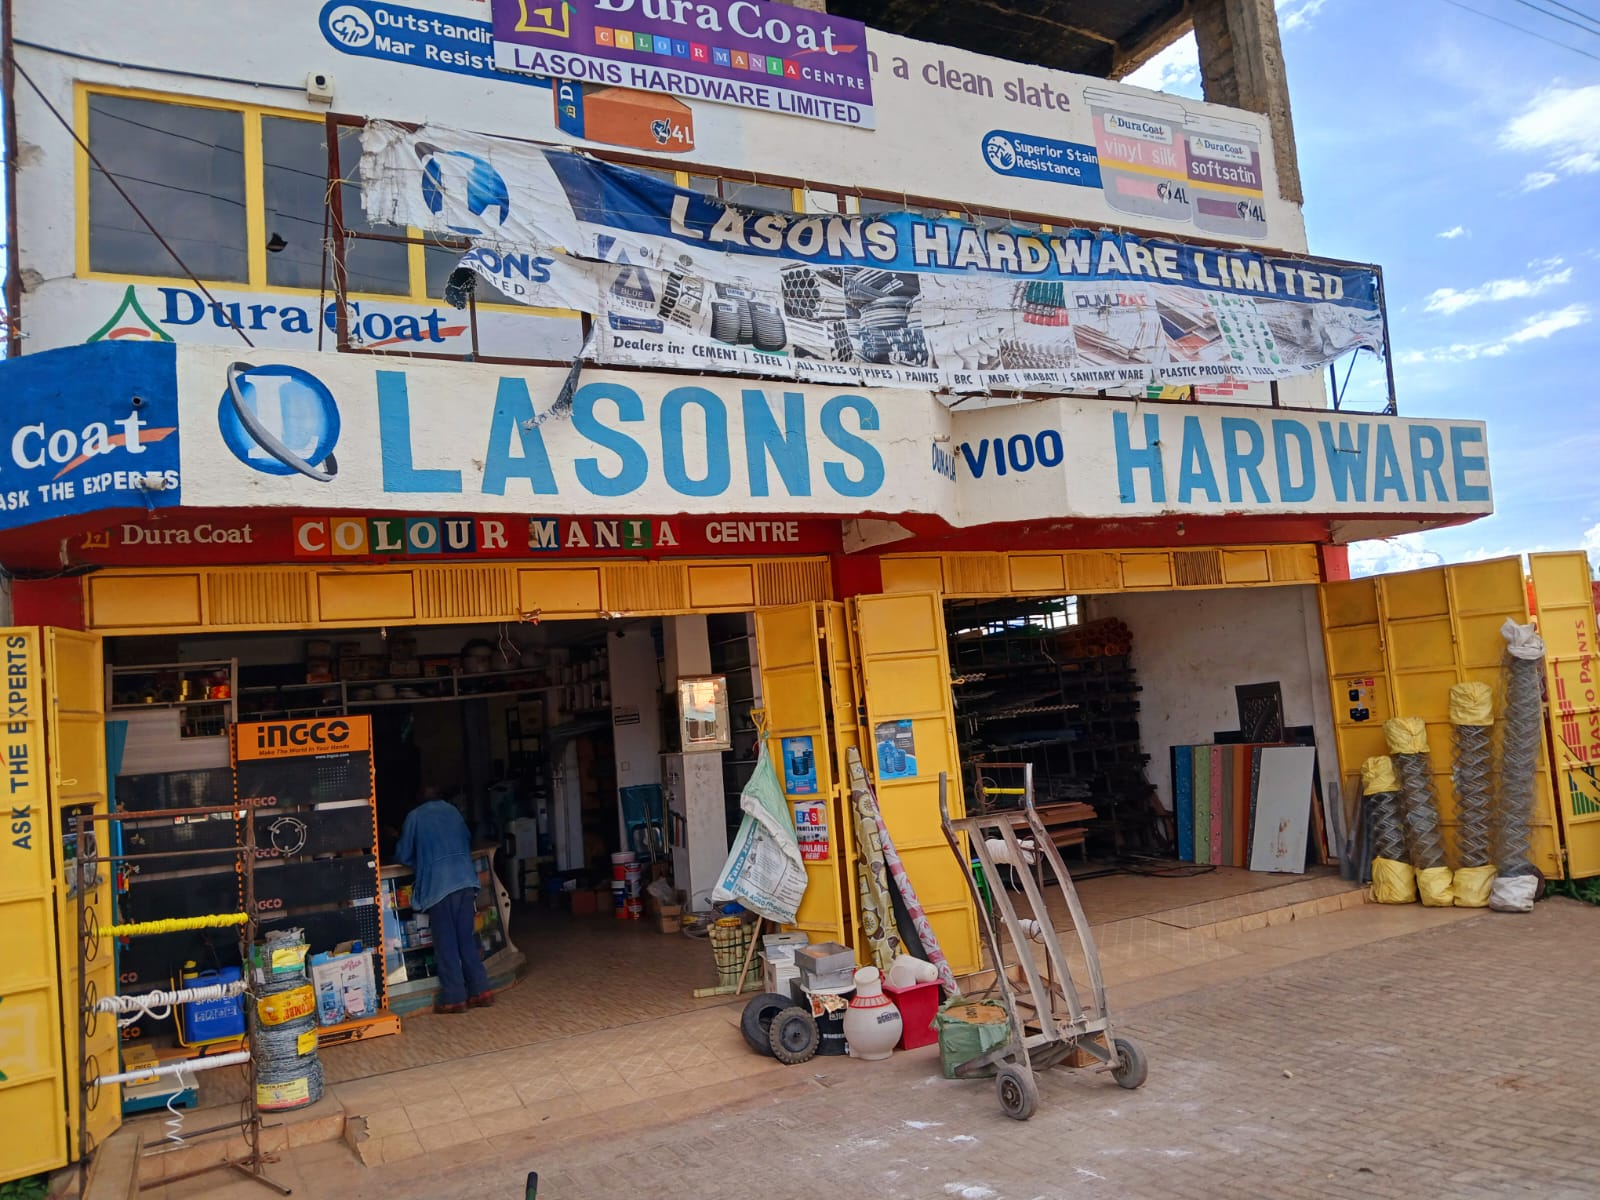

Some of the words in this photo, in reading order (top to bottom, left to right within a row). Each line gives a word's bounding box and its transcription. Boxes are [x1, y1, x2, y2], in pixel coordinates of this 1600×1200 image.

[374, 9, 494, 45] Outstandin
[375, 34, 415, 56] Mar
[597, 29, 705, 60] COLOUR
[714, 49, 797, 78] MANIA
[802, 67, 865, 90] CENTRE
[514, 48, 623, 84] LASONS
[631, 68, 771, 108] HARDWARE
[778, 92, 862, 124] LIMITED
[892, 56, 910, 80] a
[922, 60, 994, 98] clean
[1004, 77, 1071, 113] slate
[671, 124, 694, 145] 4L
[1014, 139, 1063, 158] Superior
[1066, 148, 1098, 165] Stain
[1016, 155, 1081, 177] Resistance
[1103, 139, 1143, 161] vinyl
[1152, 147, 1177, 168] silk
[1191, 160, 1256, 184] softsatin
[1173, 187, 1190, 204] 4L
[1251, 204, 1266, 222] 4L
[669, 194, 898, 262] LASONS
[913, 222, 1186, 281] HARDWARE
[1194, 251, 1344, 301] LIMITED
[613, 336, 664, 353] Dealers
[668, 341, 685, 355] in:
[692, 344, 738, 361] CEMENT
[753, 353, 783, 367] STEEL
[797, 360, 815, 371] ALL
[816, 363, 847, 375] TYPES
[849, 367, 862, 376] OF
[864, 368, 893, 380] PIPES
[905, 371, 939, 384] PAINTS
[954, 374, 974, 385] BRC
[988, 374, 1010, 384] MDF
[1023, 372, 1060, 383] MABATI
[1070, 370, 1116, 382] SANITARY
[1118, 368, 1144, 381] WARE
[1160, 365, 1197, 378] PLASTIC
[1199, 365, 1244, 376] PRODUCTS
[376, 369, 885, 498] LASONS
[1112, 410, 1490, 504] HARDWARE
[38, 481, 75, 503] THE
[297, 520, 509, 552] COLOUR
[530, 518, 680, 549] MANIA
[705, 520, 800, 544] CENTRE
[6, 635, 28, 735] EXPERTS
[9, 743, 29, 794] THE
[11, 804, 32, 851] ASK
[796, 811, 826, 824] EASY
